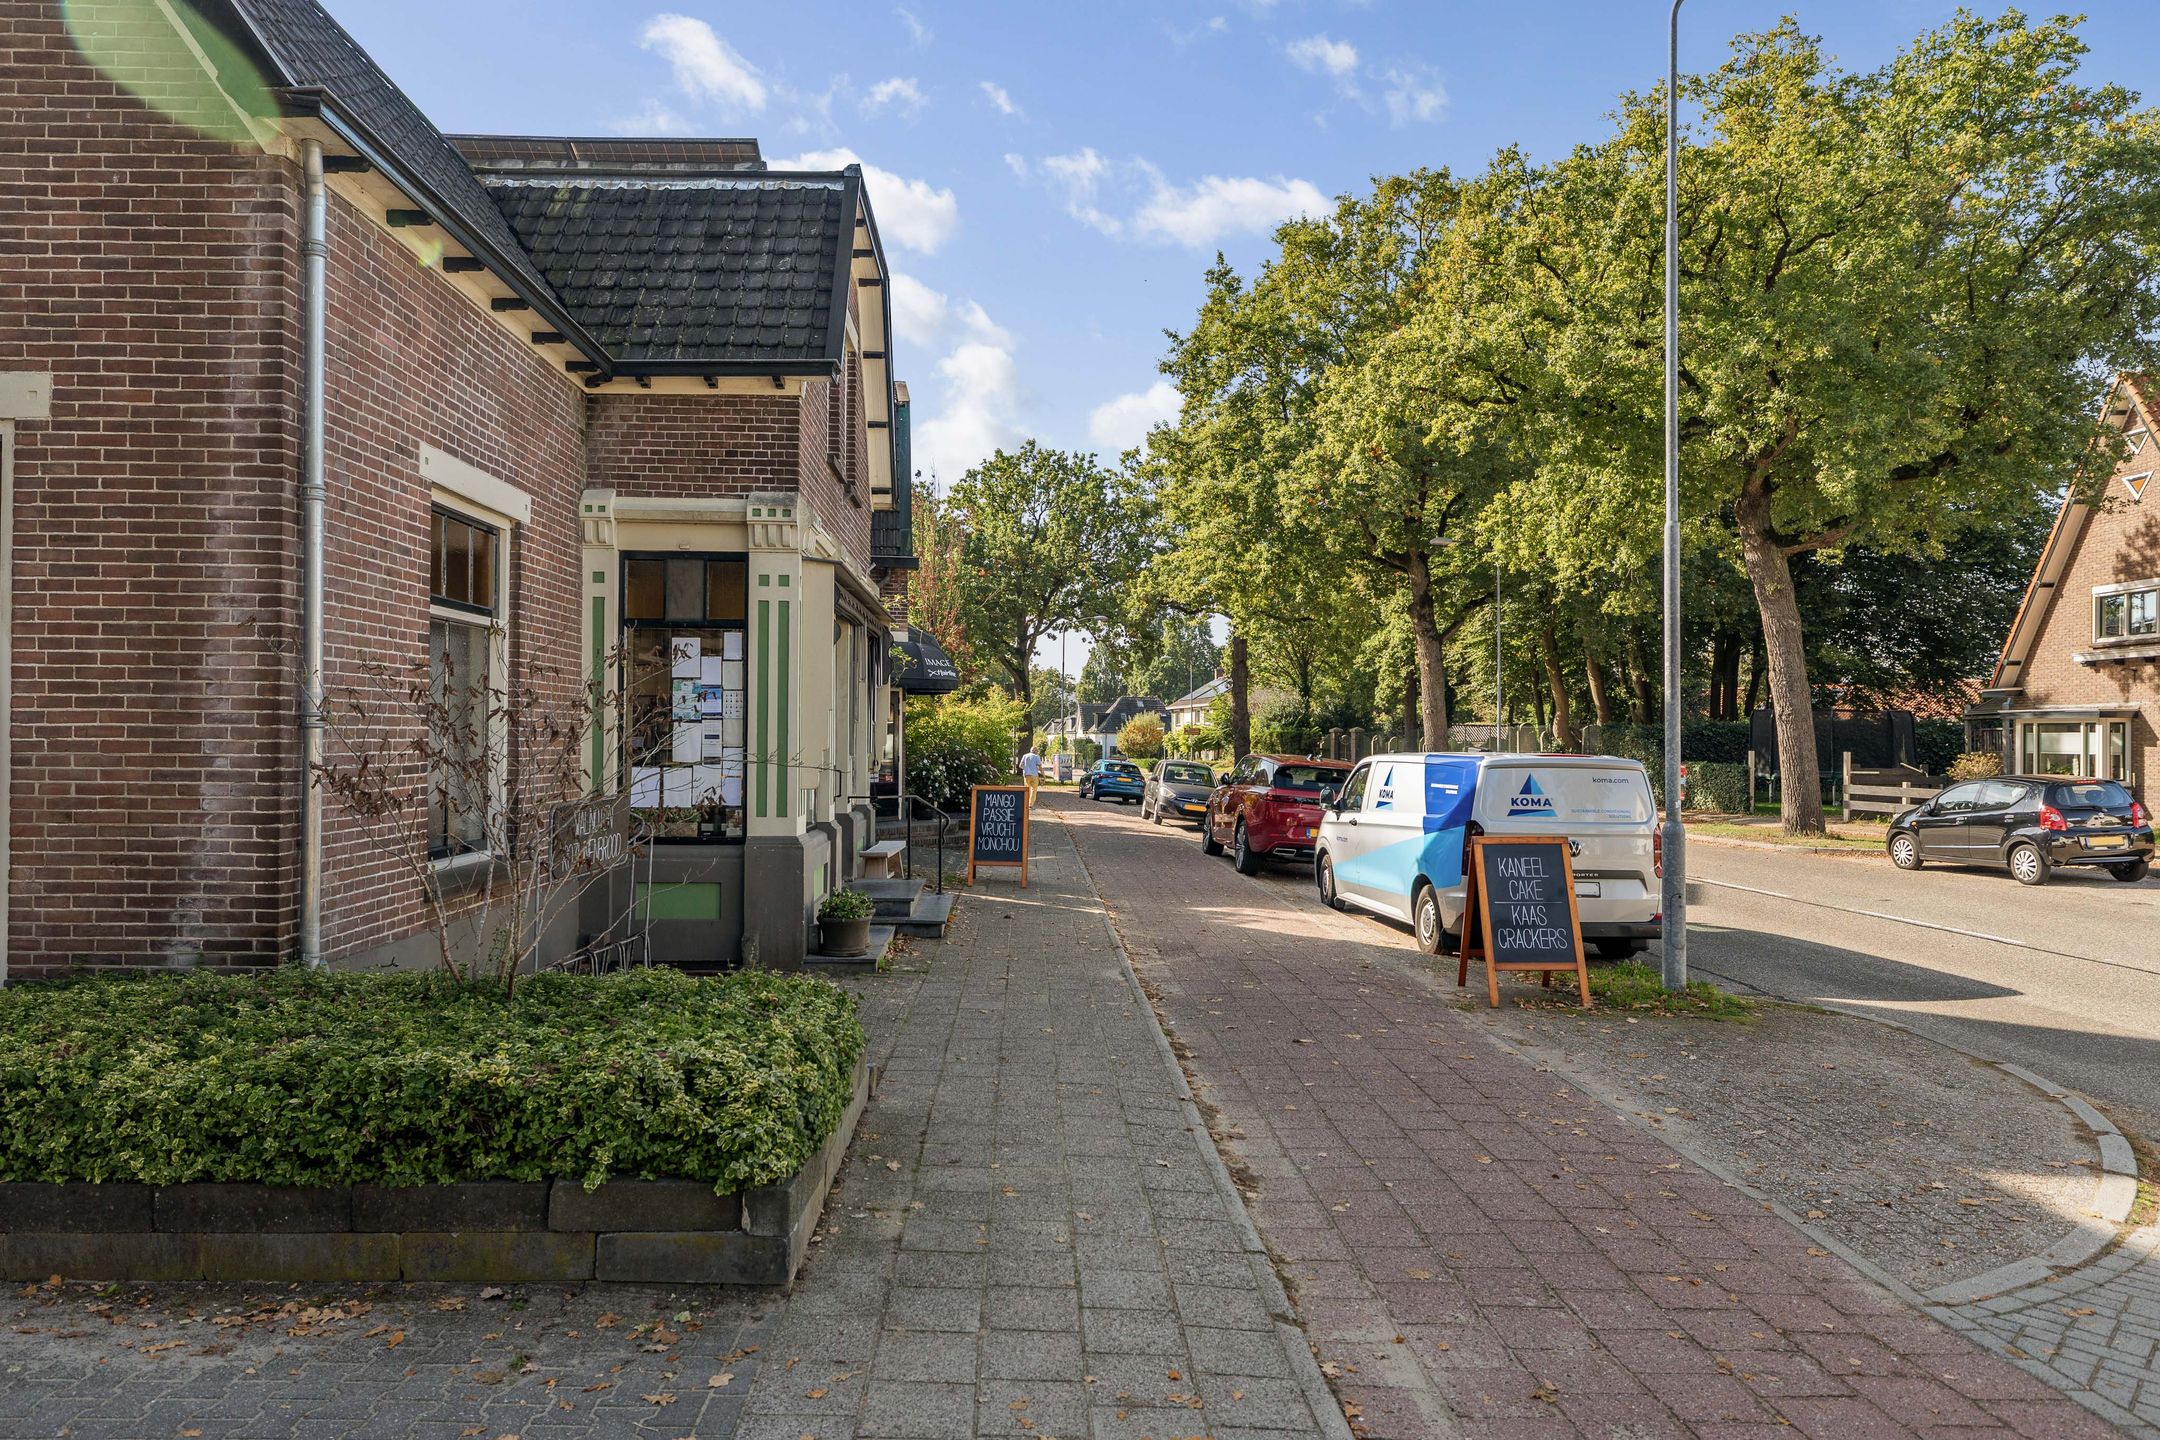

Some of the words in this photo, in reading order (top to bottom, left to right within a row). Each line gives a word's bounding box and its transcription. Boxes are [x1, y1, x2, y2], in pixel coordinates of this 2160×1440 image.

[925, 657, 951, 667] IMAGE
[1592, 776, 1629, 784] koma.com
[985, 794, 1016, 808] MANGO
[1379, 789, 1394, 800] KOMA
[1511, 797, 1552, 807] KOMA
[983, 808, 1015, 822] PASSIE
[981, 823, 1016, 837] VRUCHT
[977, 837, 1020, 851] MONCHOU
[1498, 857, 1549, 878] KANEEL
[1508, 880, 1543, 901] CAKE
[1511, 905, 1548, 926] KAAS
[1498, 929, 1568, 949] CRACKERS
